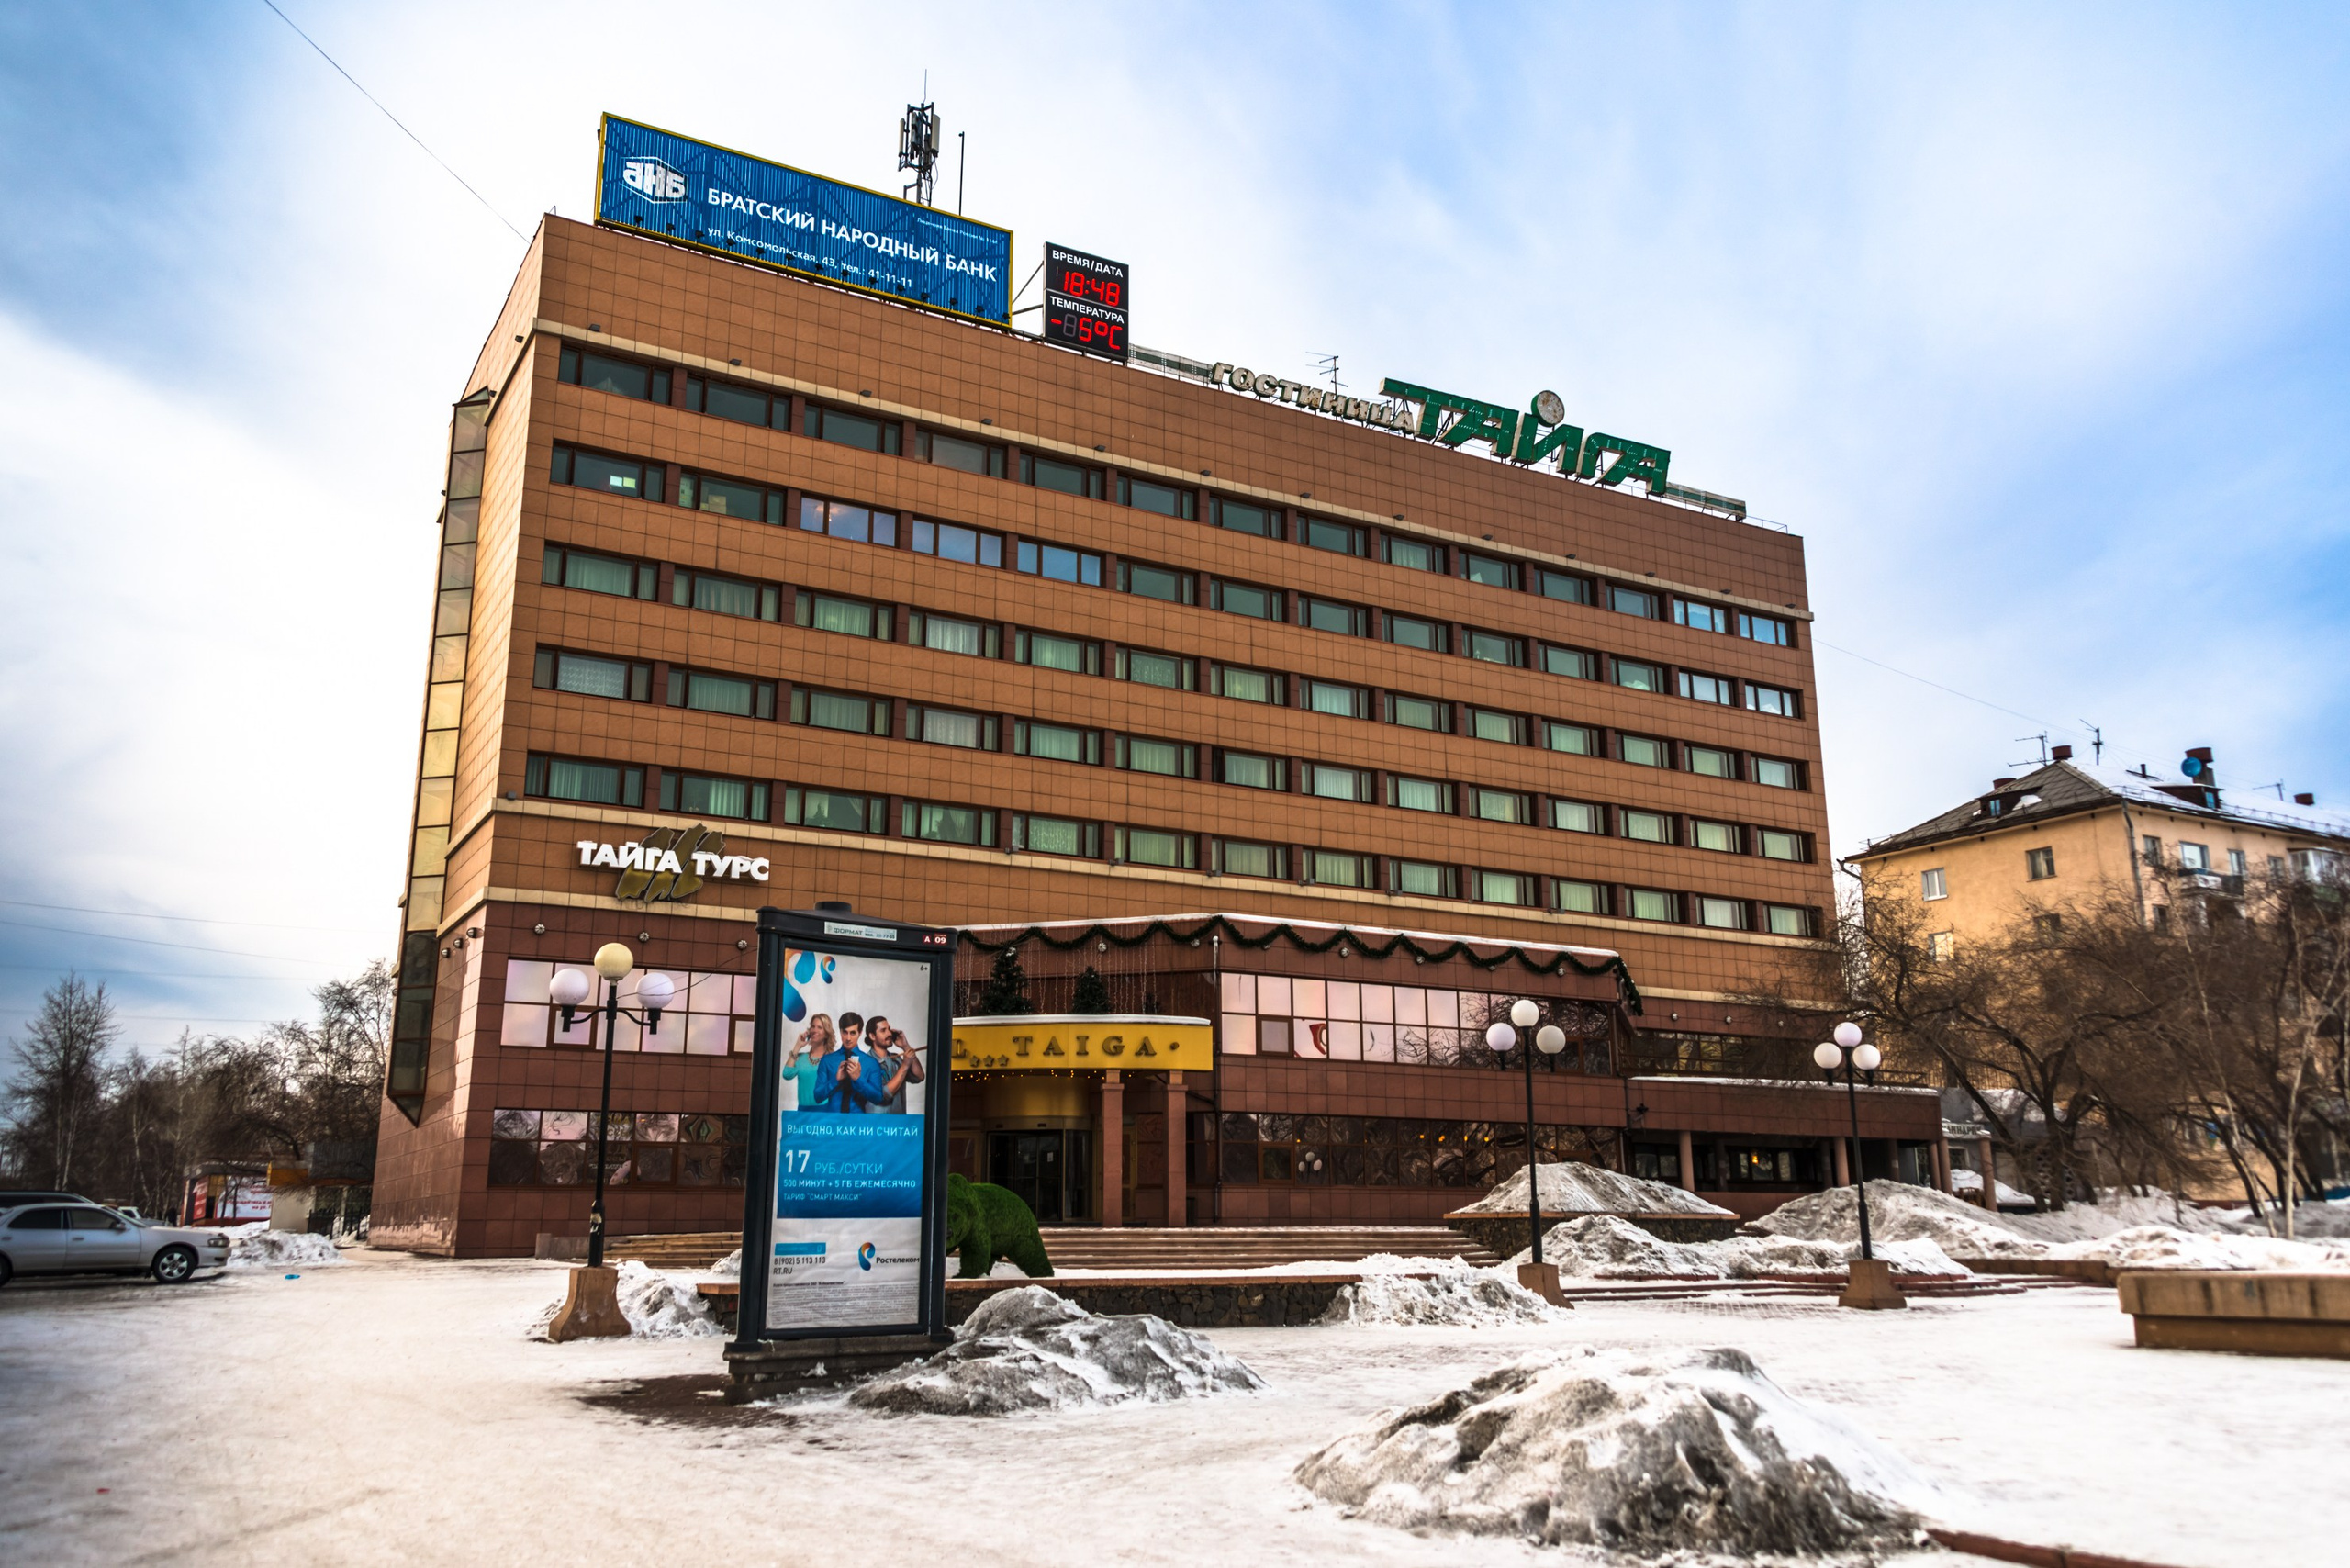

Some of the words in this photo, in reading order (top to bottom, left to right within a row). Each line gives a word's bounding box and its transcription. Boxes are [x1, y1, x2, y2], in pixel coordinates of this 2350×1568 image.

[708, 187, 815, 232] БРАТСКИЙ
[822, 219, 939, 266] НАРОДНЫЙ
[946, 253, 997, 282] БАНК
[708, 227, 724, 239] ул.
[727, 230, 819, 263] Комсомольская,
[822, 257, 838, 269] 43,
[841, 263, 866, 275] тел.:
[867, 269, 912, 288] 41-11-11
[1052, 249, 1124, 278] ВРЕМЯ/ДАТА
[1063, 271, 1121, 307] 18:48
[1049, 296, 1125, 324] ТЕМПЕРАТУРА
[1211, 361, 1416, 435] ГОСТИНИЦА
[1379, 377, 1671, 497] ТАЙГА
[576, 840, 683, 874] ТАЙГА
[691, 851, 770, 881] ТУРС
[833, 927, 863, 936] ФОРМАТ
[1013, 1036, 1157, 1057] TAIGA
[787, 1125, 834, 1137] ВЫГОДНО,
[836, 1126, 856, 1136] КАК
[858, 1126, 873, 1136] НИ
[876, 1126, 918, 1137] СЧИТАЙ
[785, 1149, 811, 1173] 17
[814, 1162, 883, 1175] РУБ./СУТКИ
[784, 1179, 797, 1188] 500
[798, 1180, 825, 1188] МИНУТ
[834, 1180, 839, 1188] 5
[842, 1180, 852, 1188] ГБ
[854, 1180, 916, 1188] ЕЖЕМЕСЯЧНО
[773, 1267, 793, 1275] RT.RU
[778, 1257, 795, 1265] (902)
[796, 1257, 800, 1265] 5
[815, 1256, 826, 1264] 113
[876, 1256, 920, 1265] Ростелеком
